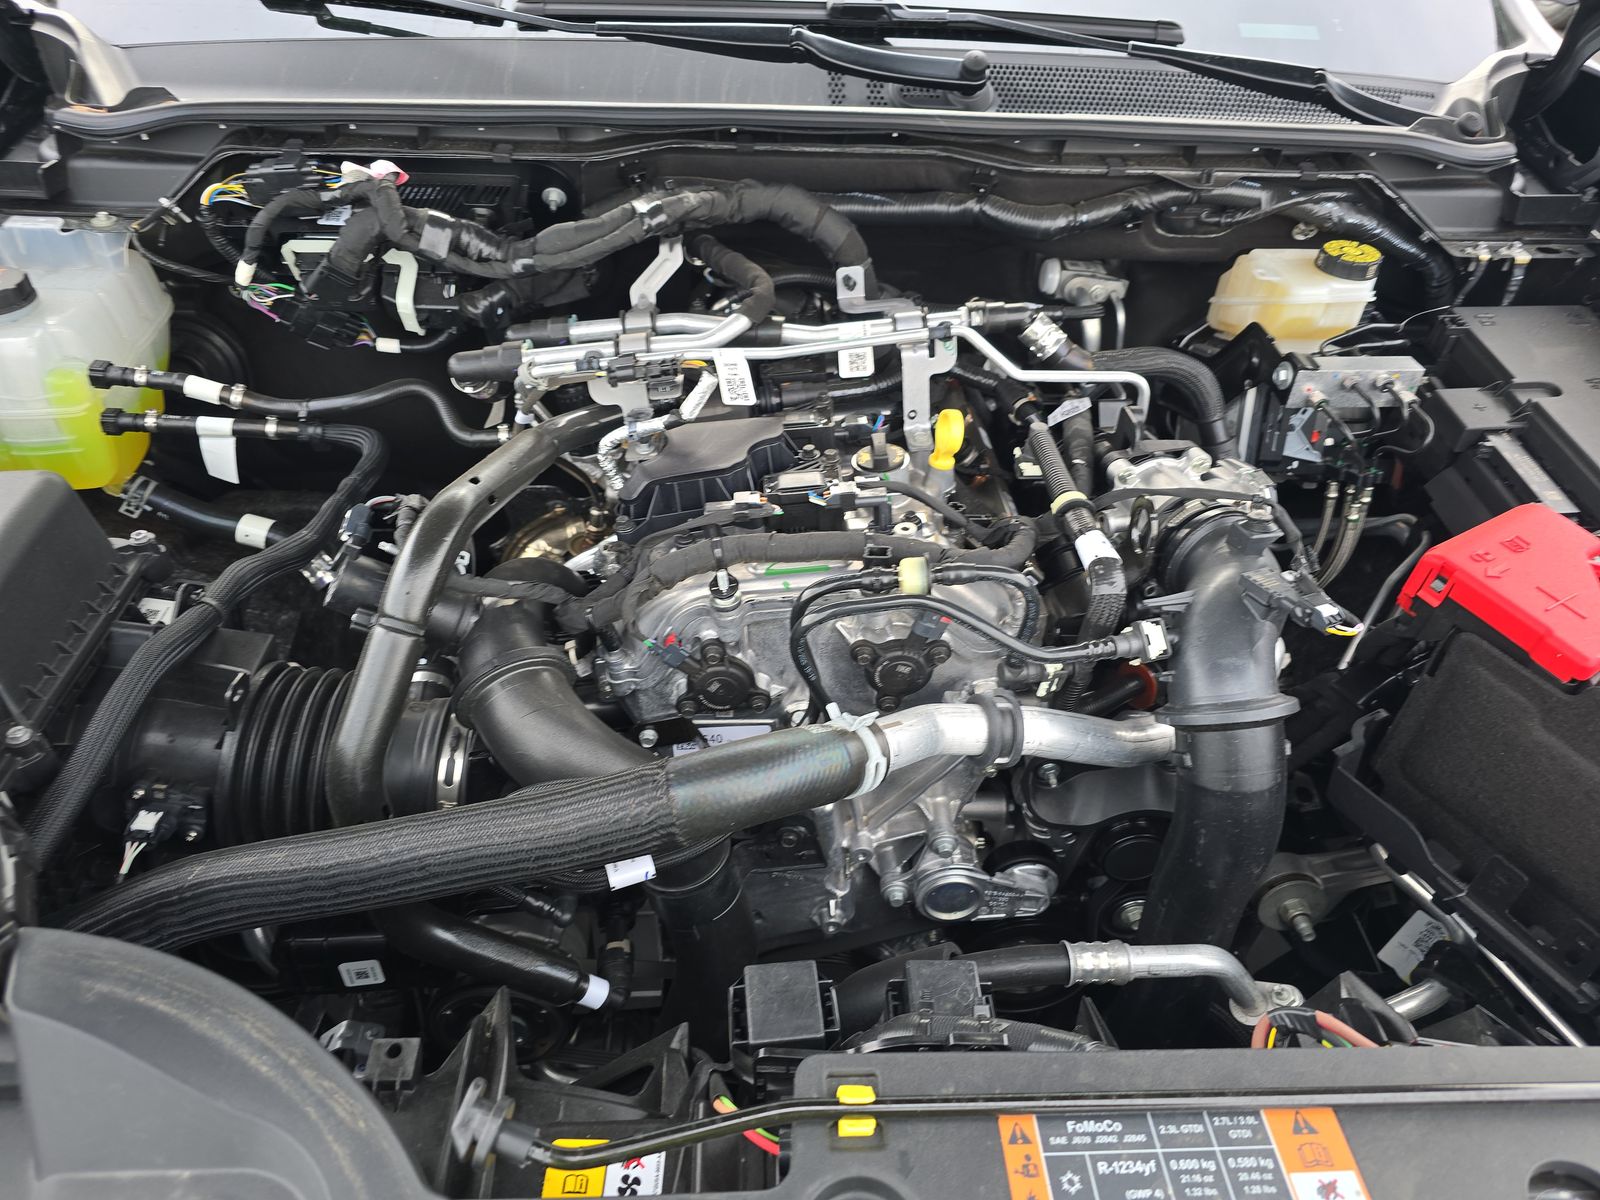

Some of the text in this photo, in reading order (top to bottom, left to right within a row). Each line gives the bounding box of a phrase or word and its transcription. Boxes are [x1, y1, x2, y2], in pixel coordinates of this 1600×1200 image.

[1066, 1120, 1123, 1133] FoMoCo
[1158, 1123, 1205, 1135] 2.3L GTDI
[1228, 1129, 1253, 1139] GTDI
[1049, 1136, 1068, 1145] SAE
[1096, 1159, 1157, 1177] R-1234yf
[1169, 1158, 1217, 1172] 0.600 kg
[1227, 1156, 1275, 1170] 0.580 kg
[1179, 1174, 1215, 1184] 21.16 oz
[1261, 1172, 1274, 1181] oz
[1125, 1188, 1165, 1200] (GWP 4)
[1202, 1187, 1218, 1196] lbs
[1262, 1185, 1278, 1194] lbs
